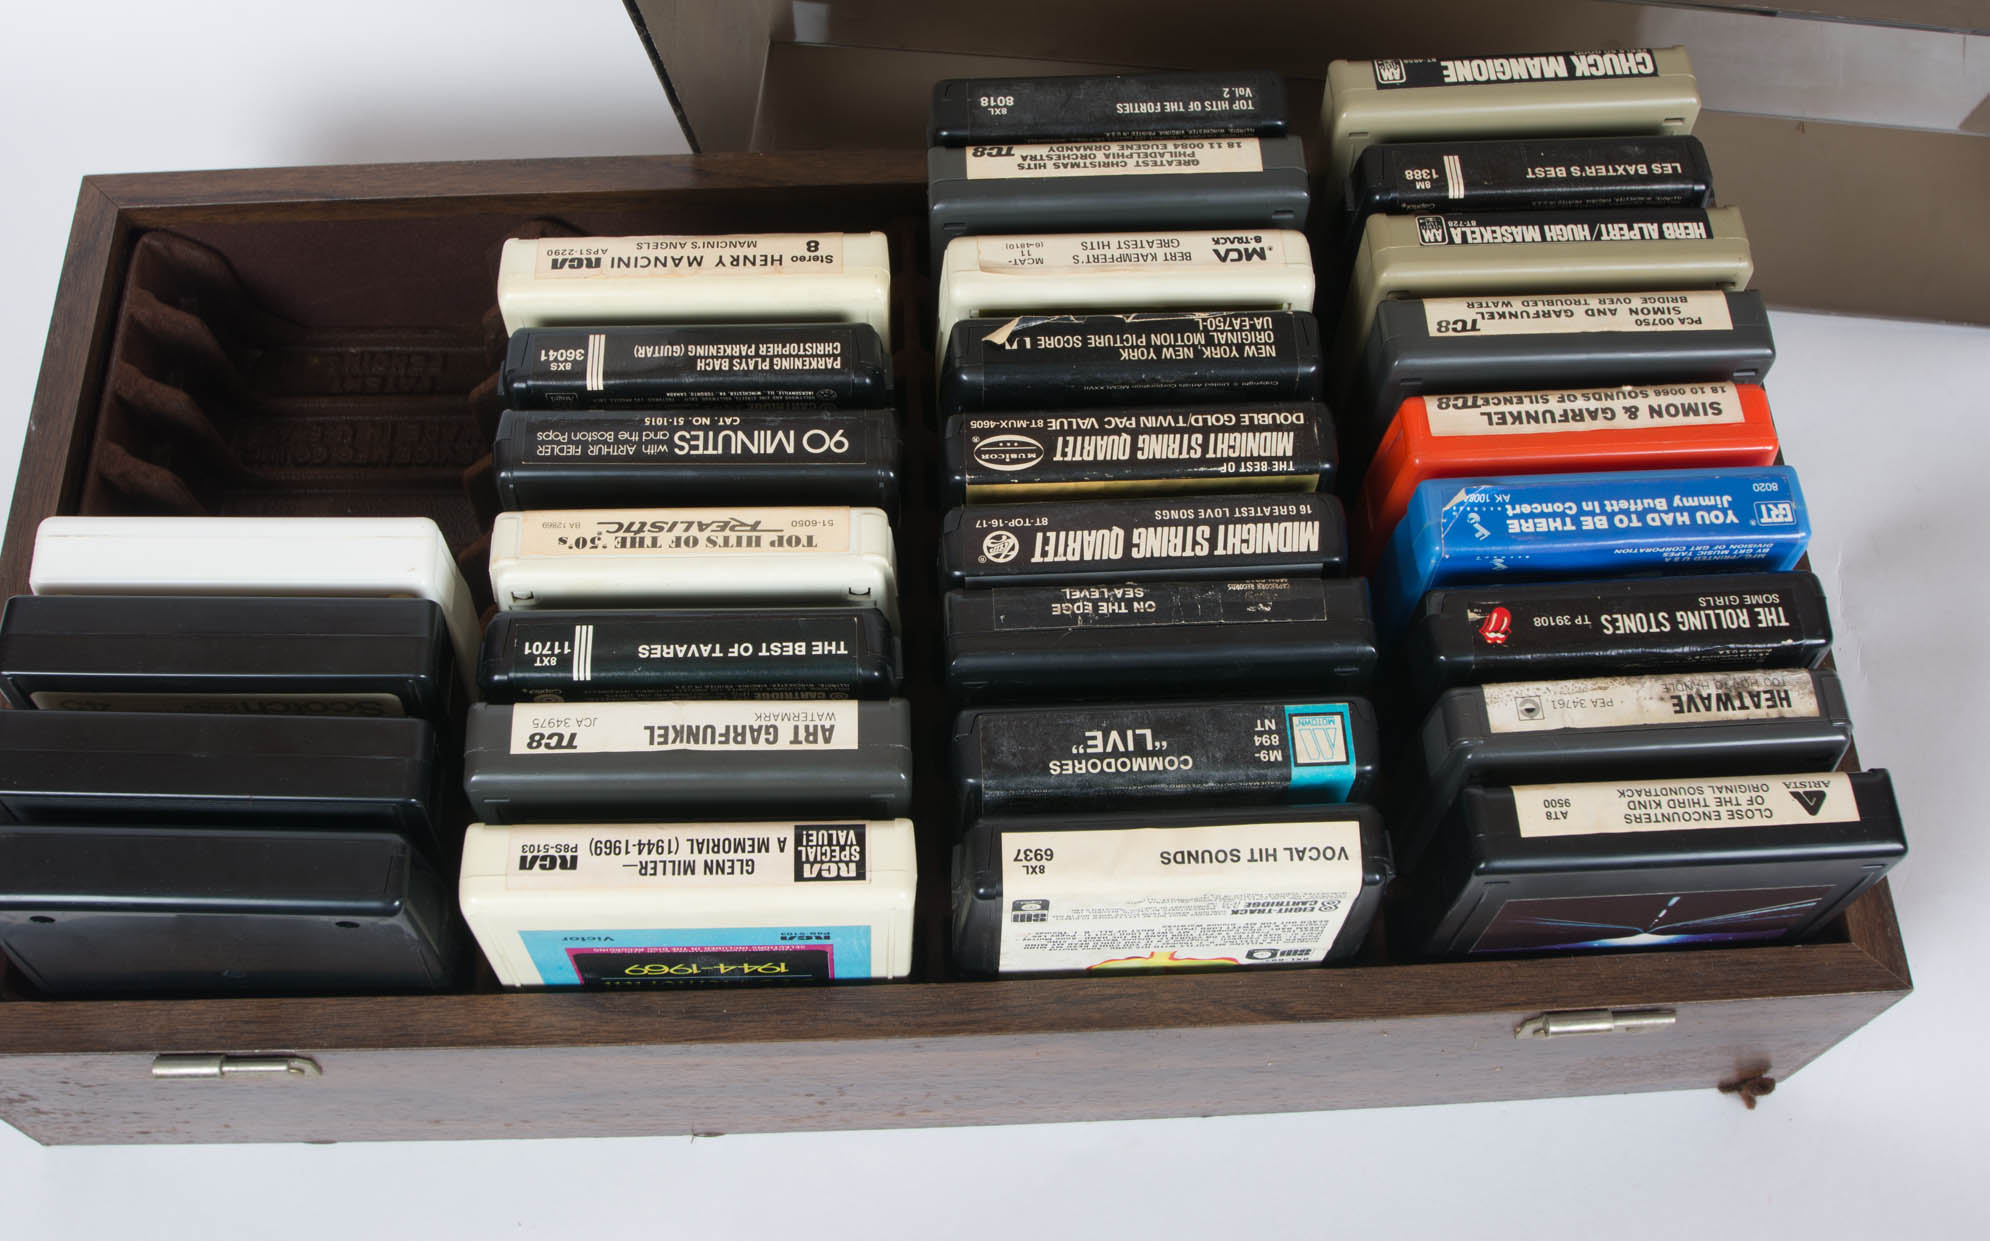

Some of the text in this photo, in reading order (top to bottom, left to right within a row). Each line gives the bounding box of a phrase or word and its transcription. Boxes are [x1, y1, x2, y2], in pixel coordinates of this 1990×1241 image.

[1440, 51, 1655, 83] CHUCK MANGIONE
[1116, 99, 1254, 114] TOP HITS OF THE FORTIES
[1020, 150, 1196, 162] PHILADELPHIA ORCHESTRA
[1017, 158, 1200, 171] GREATEST CHRISTMAS HITS
[1526, 162, 1682, 178] LES BAXTER'S BEST
[1450, 222, 1706, 243] HERB ALPERT/HUGH MASEKELA
[636, 240, 757, 251] MANCINI'S ANGELS
[1080, 238, 1180, 251] GREATEST HITS
[546, 248, 608, 257] APS1-2290
[1072, 251, 1192, 264] BERT KAEMPFERT'S
[1212, 247, 1266, 263] MCA
[551, 256, 602, 270] RCA
[609, 254, 784, 269] HENRY MANCINI
[1466, 295, 1688, 309] BRIDGE OVER TROUBLED WATER
[1475, 305, 1681, 320] SIMON AND GARFUNKEL
[1194, 316, 1272, 330] UA-EA750-L
[1037, 335, 1082, 348] SCORE
[1086, 333, 1146, 346] PICTURE
[1149, 332, 1205, 345] MOTION
[1208, 330, 1275, 344] ORIGINAL
[633, 342, 841, 359] CHRISTOPHER PARKENING (GUITAR)
[1119, 344, 1276, 360] NEW YORK, NEW YORK
[696, 356, 841, 371] PARKENING PLAYS BACH
[1239, 412, 1304, 425] DOUBLE
[1480, 401, 1723, 427] SIMON & GARFUNKEL
[1046, 417, 1099, 430] VALUE
[1104, 415, 1136, 429] PAC
[537, 428, 669, 443] and the Boston Pops
[674, 429, 850, 455] 90 MINUTES
[536, 444, 669, 456] with ARTHUR FIEDLER
[1052, 431, 1294, 462] MIDNIGHT STRING QUARTET
[1219, 461, 1295, 473] THE BEST OF
[1154, 504, 1312, 520] 16 GREATEST LOVE SONGS
[1506, 494, 1732, 517] Jimmy Buffett In Concert
[1759, 503, 1791, 523] GRT
[791, 518, 834, 528] 51-6050
[975, 517, 1048, 528] 8T-TOP-16-17
[1506, 510, 1738, 533] YOU HAD TO BE THERE
[614, 535, 662, 549] THE
[670, 535, 699, 548] OF
[706, 534, 761, 548] HITS
[769, 534, 818, 548] TOP
[1031, 521, 1319, 563] MIDNIGHT STRING QUARTET
[1614, 546, 1687, 554] CORPORATION
[1051, 600, 1157, 615] ON THE EDGE
[1698, 593, 1780, 607] SOME GIRLS
[1600, 606, 1789, 634] THE ROLLING STONES
[638, 641, 848, 658] THE BEST OF TAVARES
[1669, 689, 1792, 714] HEATWAVE
[532, 717, 598, 728] JCA 34975
[754, 712, 836, 722] WATERMARK
[1298, 717, 1336, 726] MOTOWN
[526, 732, 578, 750] TC8
[643, 724, 835, 746] ART GARFUNKEL
[1048, 755, 1193, 775] COMMODORES
[1616, 782, 1770, 799] ORIGINAL SOUNDTRACK
[1783, 780, 1831, 789] ARISTA
[1626, 795, 1765, 811] OF THE THIRD KIND
[1623, 807, 1773, 824] CLOSE ENCOUNTERS
[802, 830, 857, 846] VALUE!
[521, 843, 578, 854] P8S-5103
[589, 837, 787, 856] A MEMORIAL (1944-1969)
[798, 845, 860, 861] SPECIAL
[519, 855, 578, 871] RCA
[1159, 846, 1349, 865] VOCAL HIT SOUNDS
[701, 859, 755, 874] GLENN
[803, 863, 857, 878] RCA
[1230, 907, 1315, 916] EIGHT-TRACK
[1242, 900, 1319, 908] CARTRIDGE
[624, 961, 788, 975] 1944-1969
